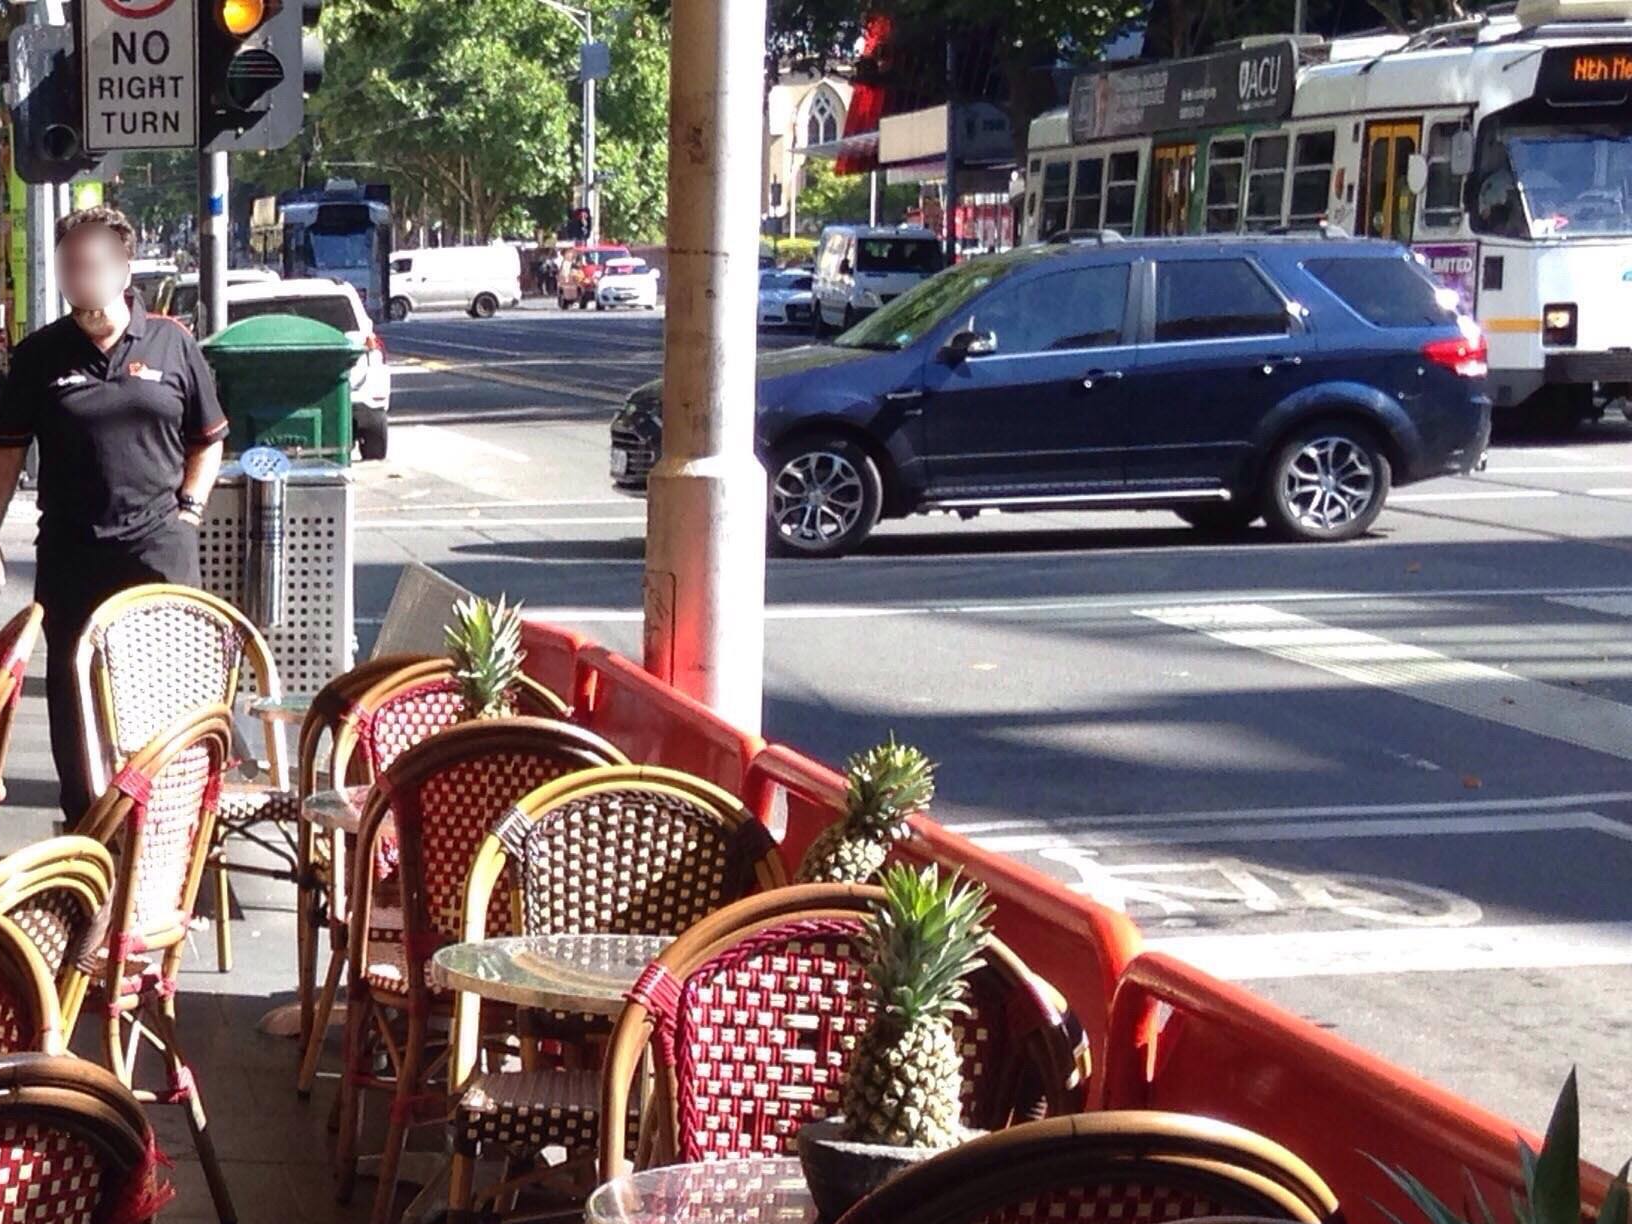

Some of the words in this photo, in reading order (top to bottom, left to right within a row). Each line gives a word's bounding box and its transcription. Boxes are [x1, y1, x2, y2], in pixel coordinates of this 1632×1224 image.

[112, 30, 170, 65] NO
[99, 75, 184, 100] RIGHT
[1248, 56, 1281, 97] ACU
[101, 110, 179, 134] TURN
